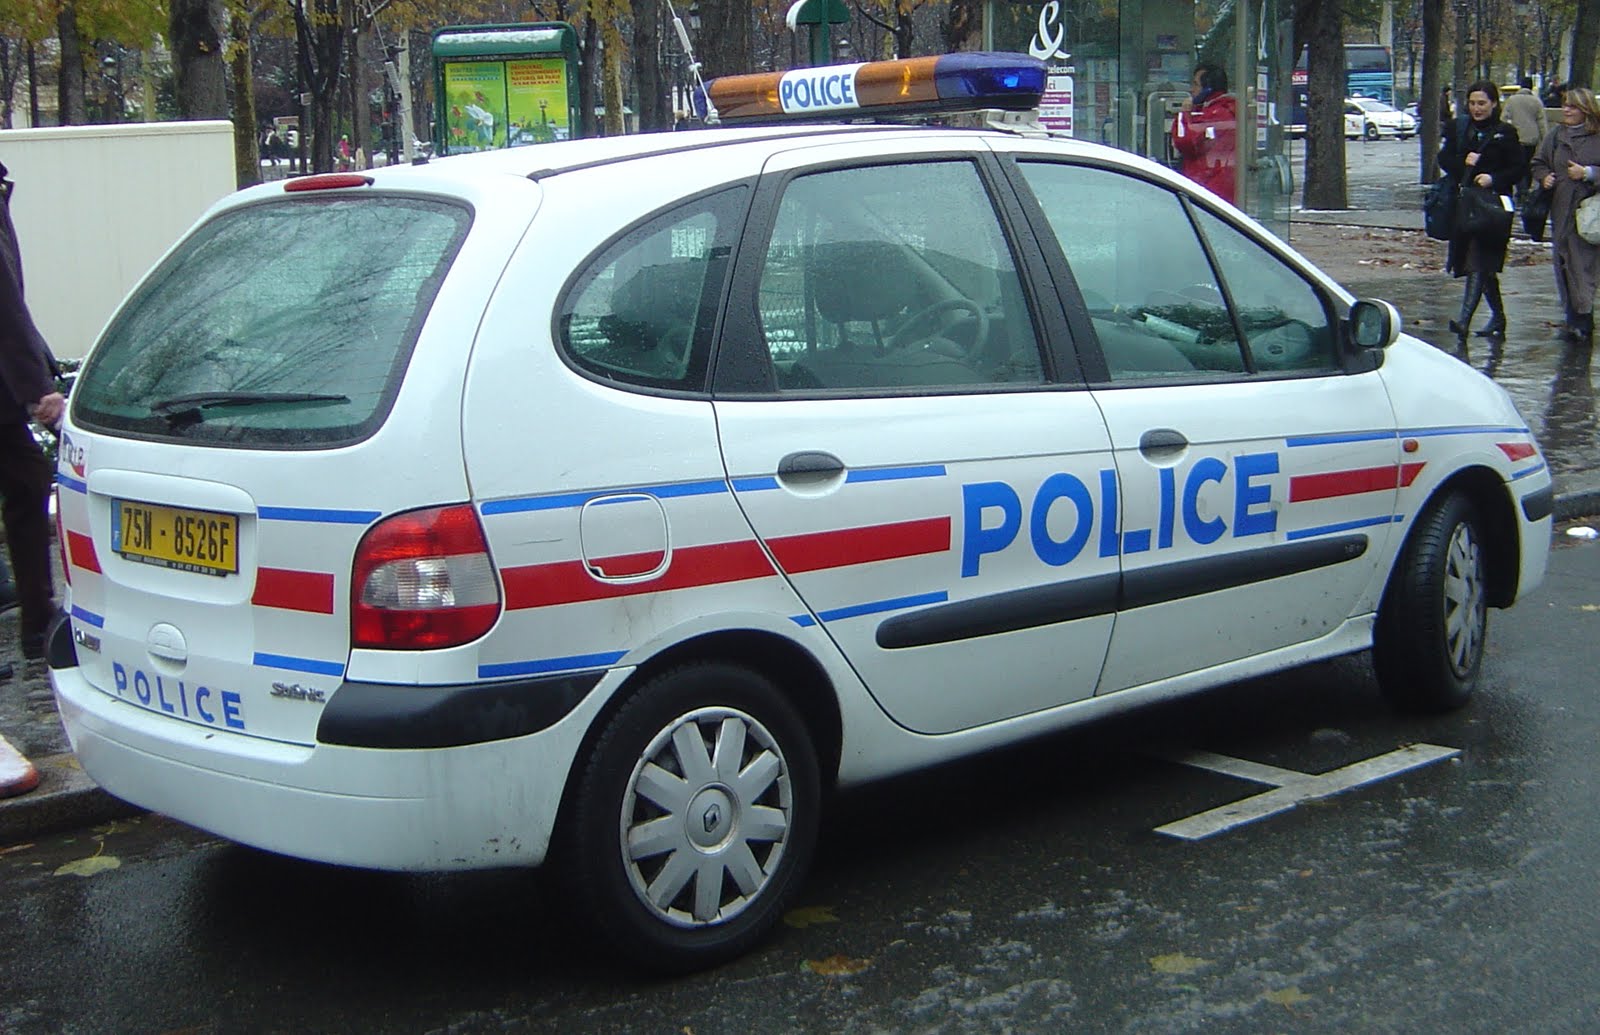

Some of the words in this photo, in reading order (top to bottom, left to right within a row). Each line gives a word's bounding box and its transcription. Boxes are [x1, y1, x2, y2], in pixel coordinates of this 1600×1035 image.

[781, 73, 854, 109] POLICE
[123, 507, 152, 550] 75N
[174, 515, 230, 562] 8526F
[961, 452, 1280, 578] POLICE
[112, 661, 245, 730] POLICE
